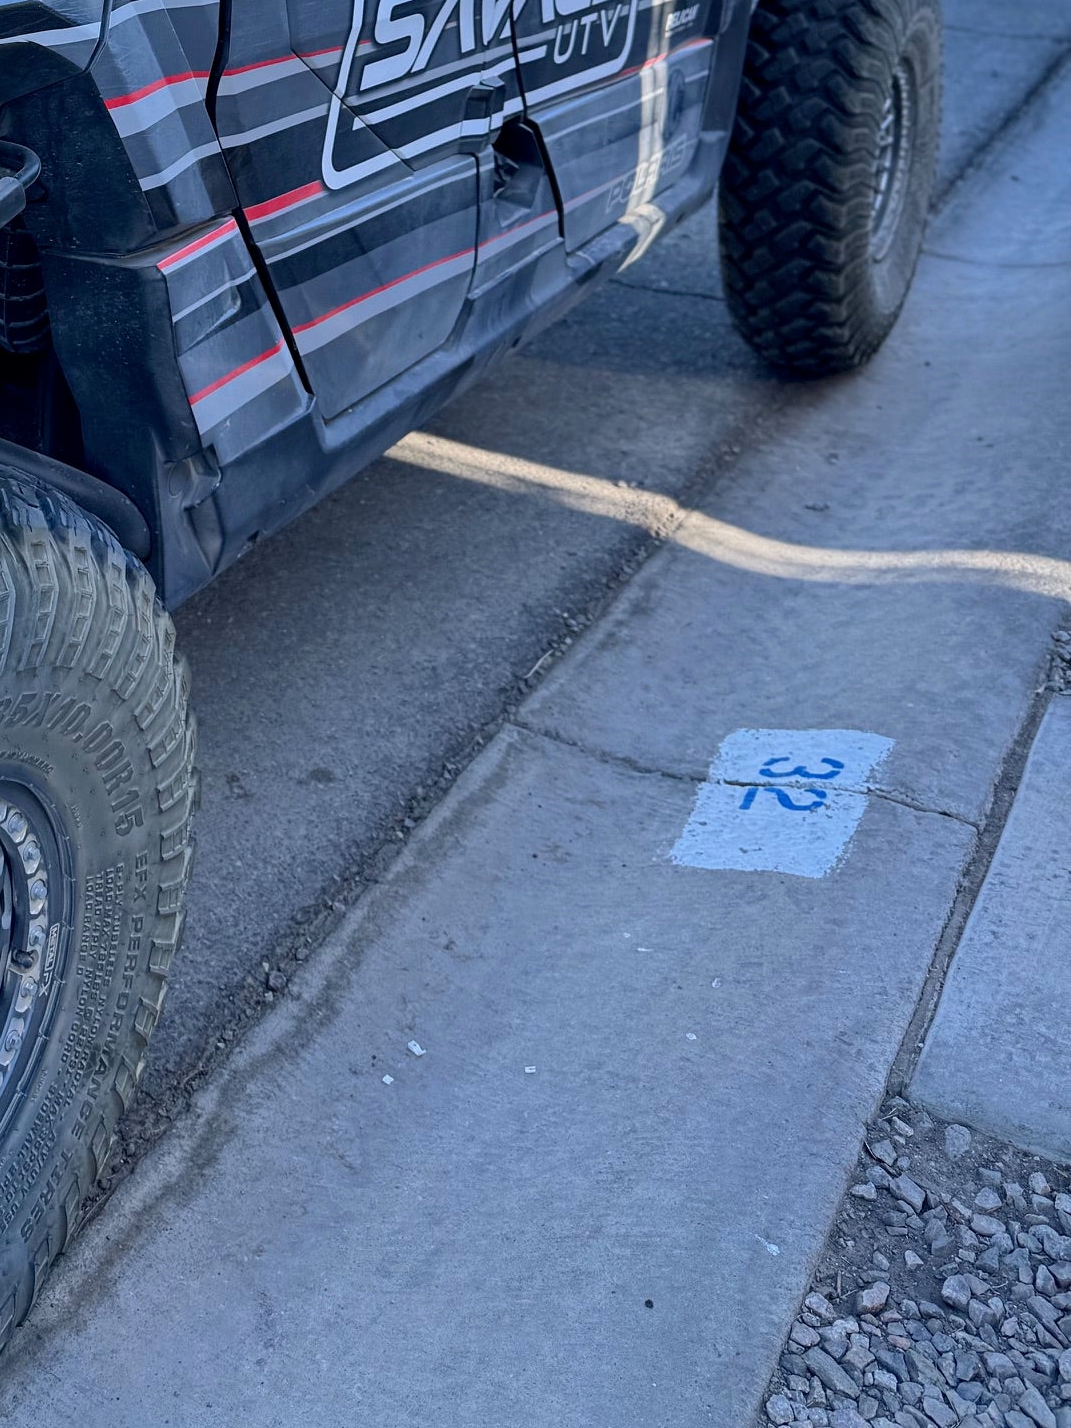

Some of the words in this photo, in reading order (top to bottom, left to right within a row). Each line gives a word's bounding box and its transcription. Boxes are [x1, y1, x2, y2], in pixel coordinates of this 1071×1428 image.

[553, 3, 622, 64] UTV
[133, 849, 148, 903] EFX
[102, 912, 122, 987] TUBELESS
[75, 967, 93, 1018] NYLON
[87, 994, 107, 1045] NYLON
[71, 913, 143, 1140] PERFORMANCE
[20, 1148, 74, 1244] TIRES
